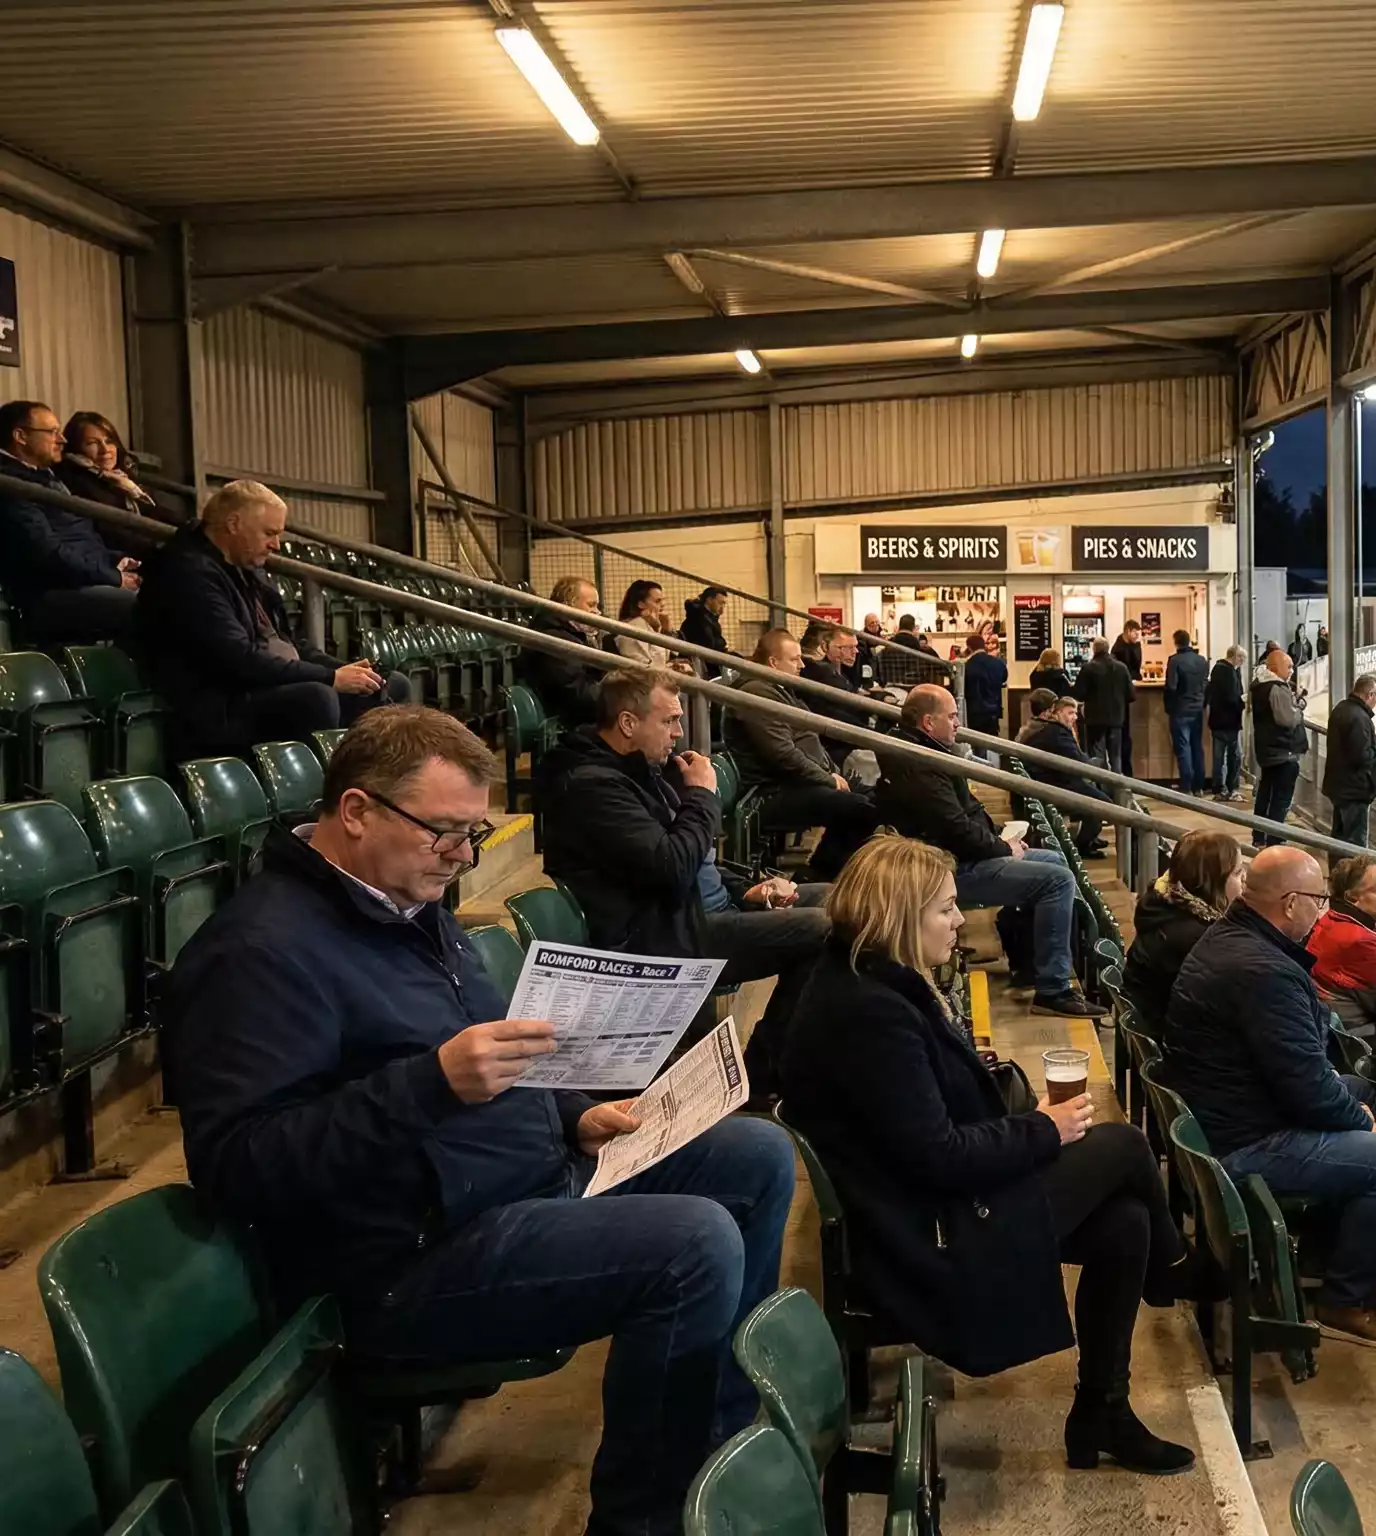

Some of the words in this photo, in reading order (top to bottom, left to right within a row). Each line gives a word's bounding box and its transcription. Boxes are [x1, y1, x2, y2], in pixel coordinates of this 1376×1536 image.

[867, 537, 919, 559] BEERS
[923, 536, 935, 559] &
[938, 537, 999, 559] SPIRITS
[1084, 537, 1118, 559] PIES
[1121, 538, 1133, 559] &
[1137, 537, 1197, 559] SNACKS
[539, 951, 597, 971] ROMFORD
[598, 960, 635, 975] RACES
[641, 966, 666, 977] Race
[667, 966, 677, 977] 7
